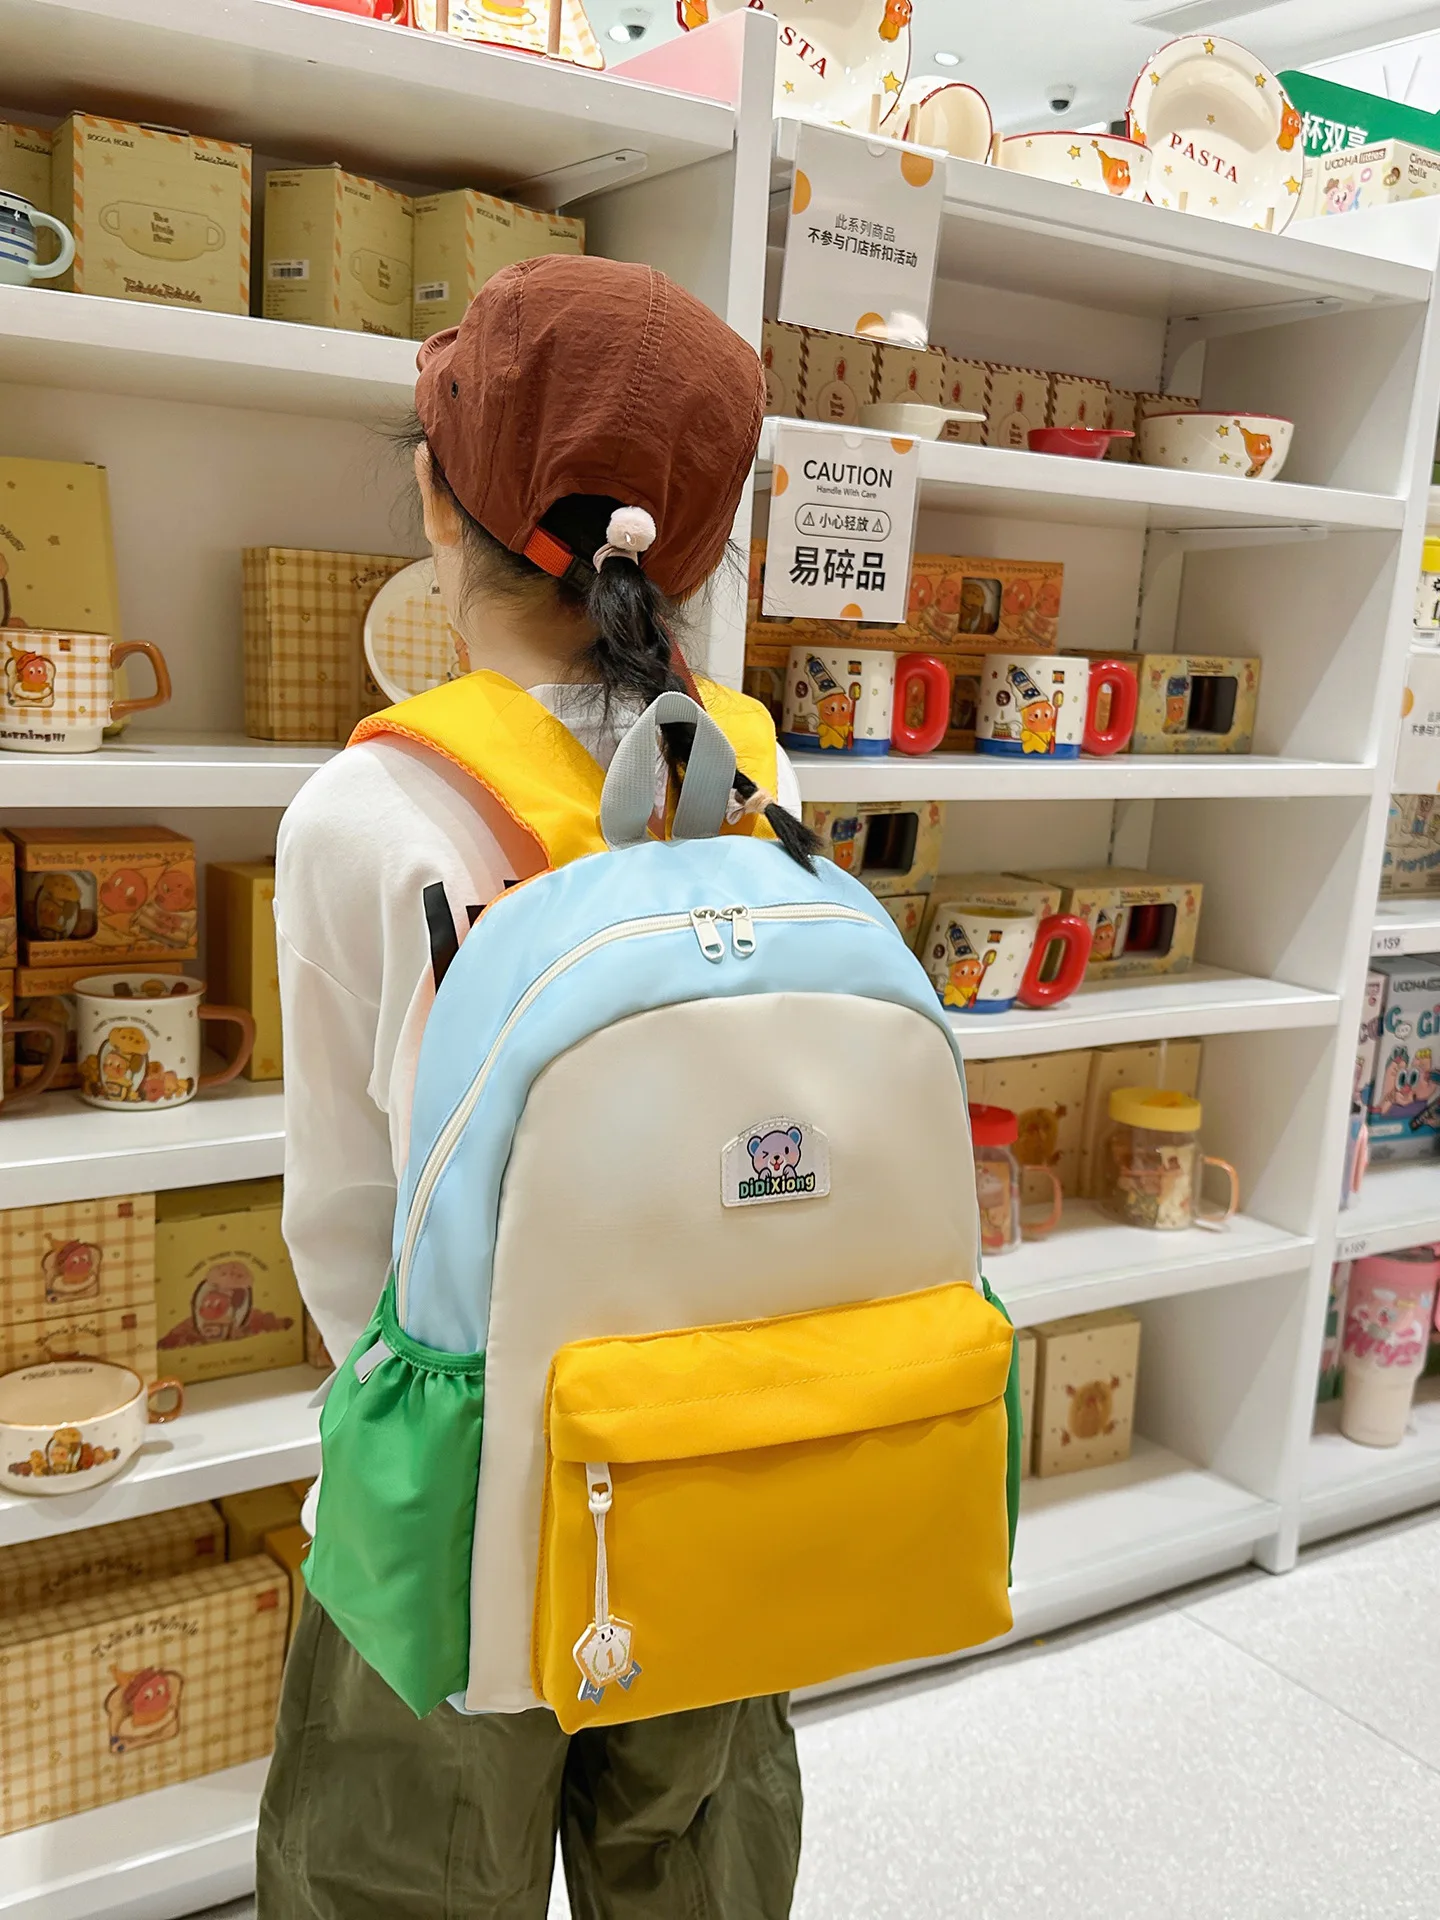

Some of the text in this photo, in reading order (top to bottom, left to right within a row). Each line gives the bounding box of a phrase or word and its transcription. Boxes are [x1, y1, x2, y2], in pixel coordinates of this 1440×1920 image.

[1169, 132, 1239, 184] PASTA
[1408, 164, 1428, 179] Rolls
[835, 212, 896, 243] 此系列商品
[807, 226, 919, 269] 不参与门店折扣活动
[803, 459, 893, 489] CAUTION
[816, 485, 878, 500] Handle With Care
[819, 512, 870, 533] 小心轻放
[788, 545, 887, 592] 易碎品
[738, 1171, 816, 1200] DiDiXiong
[606, 1647, 617, 1670] 1
